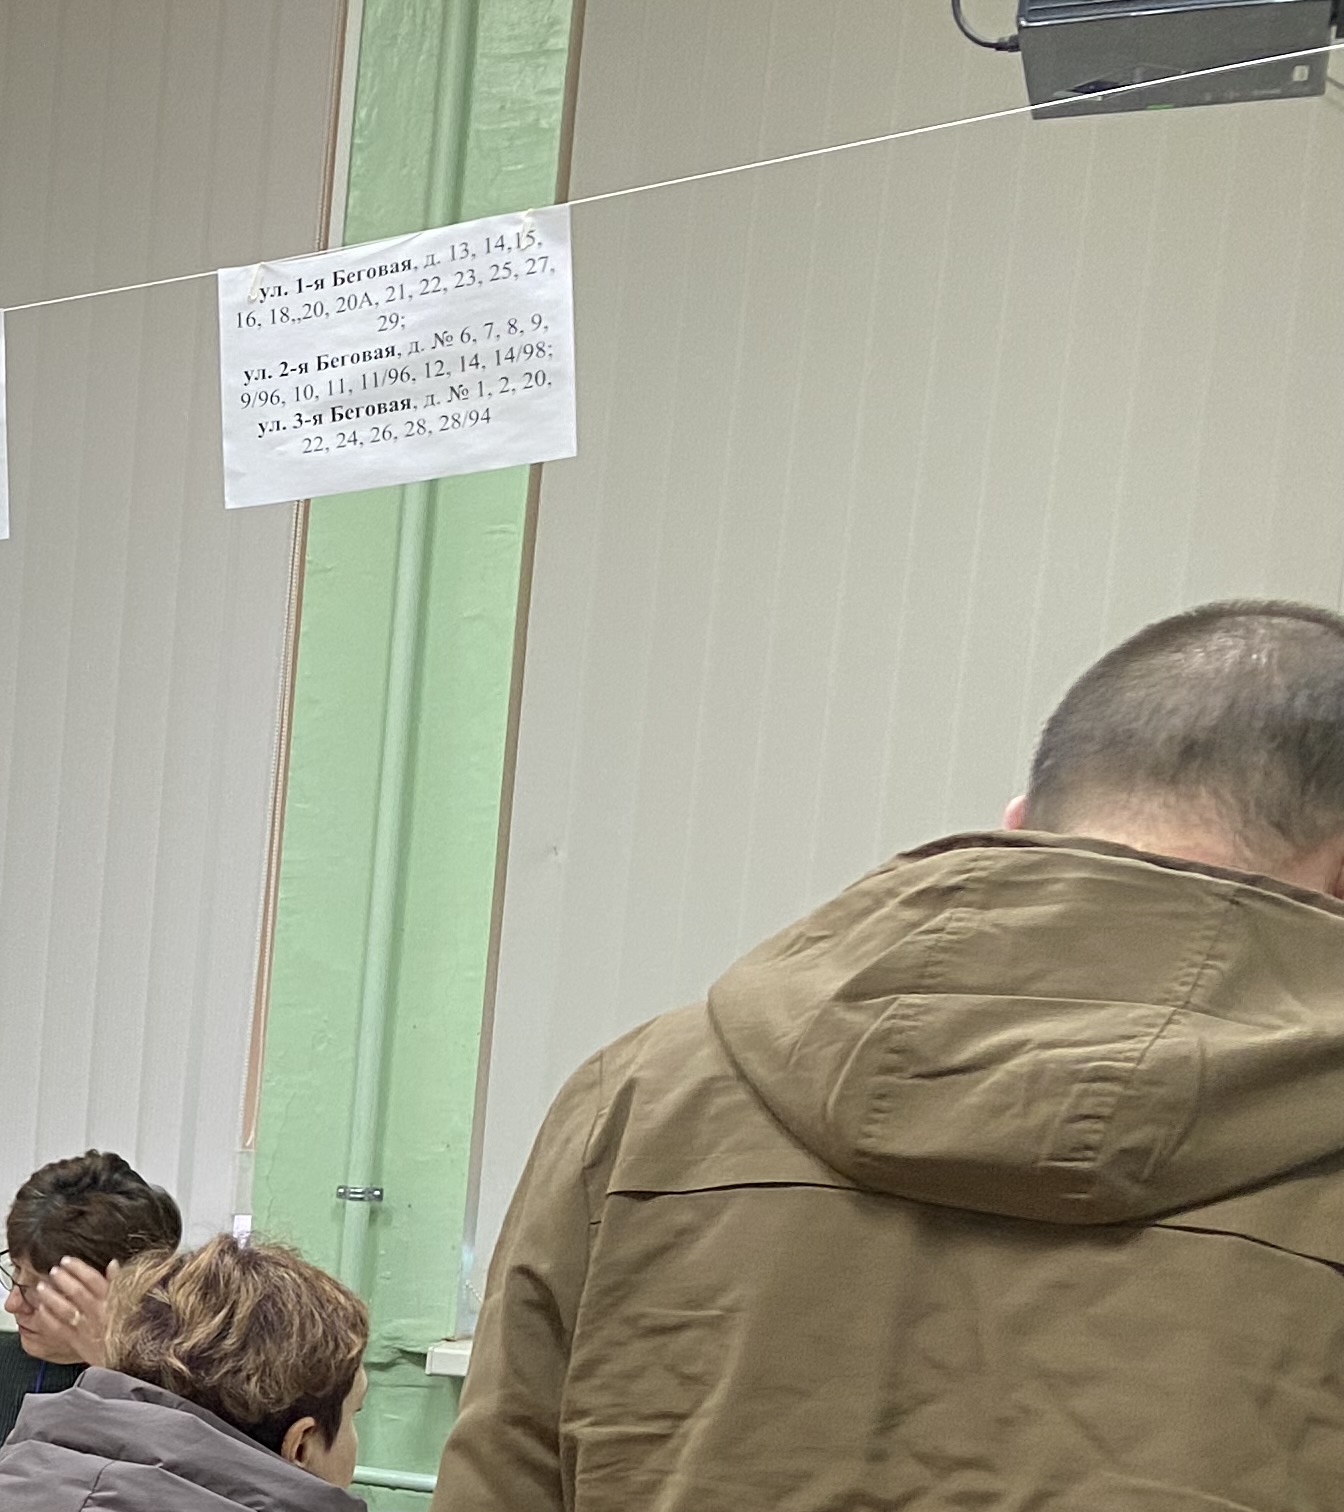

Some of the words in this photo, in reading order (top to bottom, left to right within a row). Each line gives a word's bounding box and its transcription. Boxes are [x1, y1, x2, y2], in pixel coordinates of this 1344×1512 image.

[236, 310, 262, 330] 16,
[335, 291, 380, 314] 20А,
[385, 284, 413, 303] 21,
[419, 276, 448, 296] 22,
[454, 268, 483, 288] 23,
[489, 261, 519, 282] 25,
[525, 256, 556, 276] 27,
[259, 286, 288, 303] ул.
[296, 278, 325, 294] 1-я
[332, 258, 418, 287] Беговая,
[423, 254, 441, 270] д.
[450, 241, 476, 262] 13,
[243, 368, 273, 386] ул.
[279, 361, 309, 377] 2-я
[316, 344, 402, 371] Беговая,
[408, 340, 424, 356] д.
[431, 330, 453, 350] №
[460, 326, 477, 344] 6,
[483, 321, 500, 340] 7,
[507, 317, 524, 336] 8,
[531, 313, 549, 332] 9,
[377, 312, 406, 332] 29;
[240, 388, 286, 410] 9/96,
[294, 383, 319, 402] 10,
[328, 378, 353, 397] 11,
[361, 365, 416, 390] 11/96,
[424, 359, 451, 379] 12,
[460, 353, 486, 373] 14,
[495, 341, 553, 366] 14/98;
[257, 420, 287, 438] ул.
[292, 412, 323, 429] 3-я
[330, 397, 418, 423] Беговая,
[423, 394, 441, 409] д.
[446, 384, 469, 403] №
[477, 380, 493, 398] 1,
[498, 376, 516, 395] 2,
[522, 369, 552, 390] 20,
[302, 436, 330, 454] 22,
[336, 430, 364, 449] 24,
[370, 423, 398, 443] 26,
[404, 418, 433, 438] 28,
[439, 407, 491, 432] 28/94
